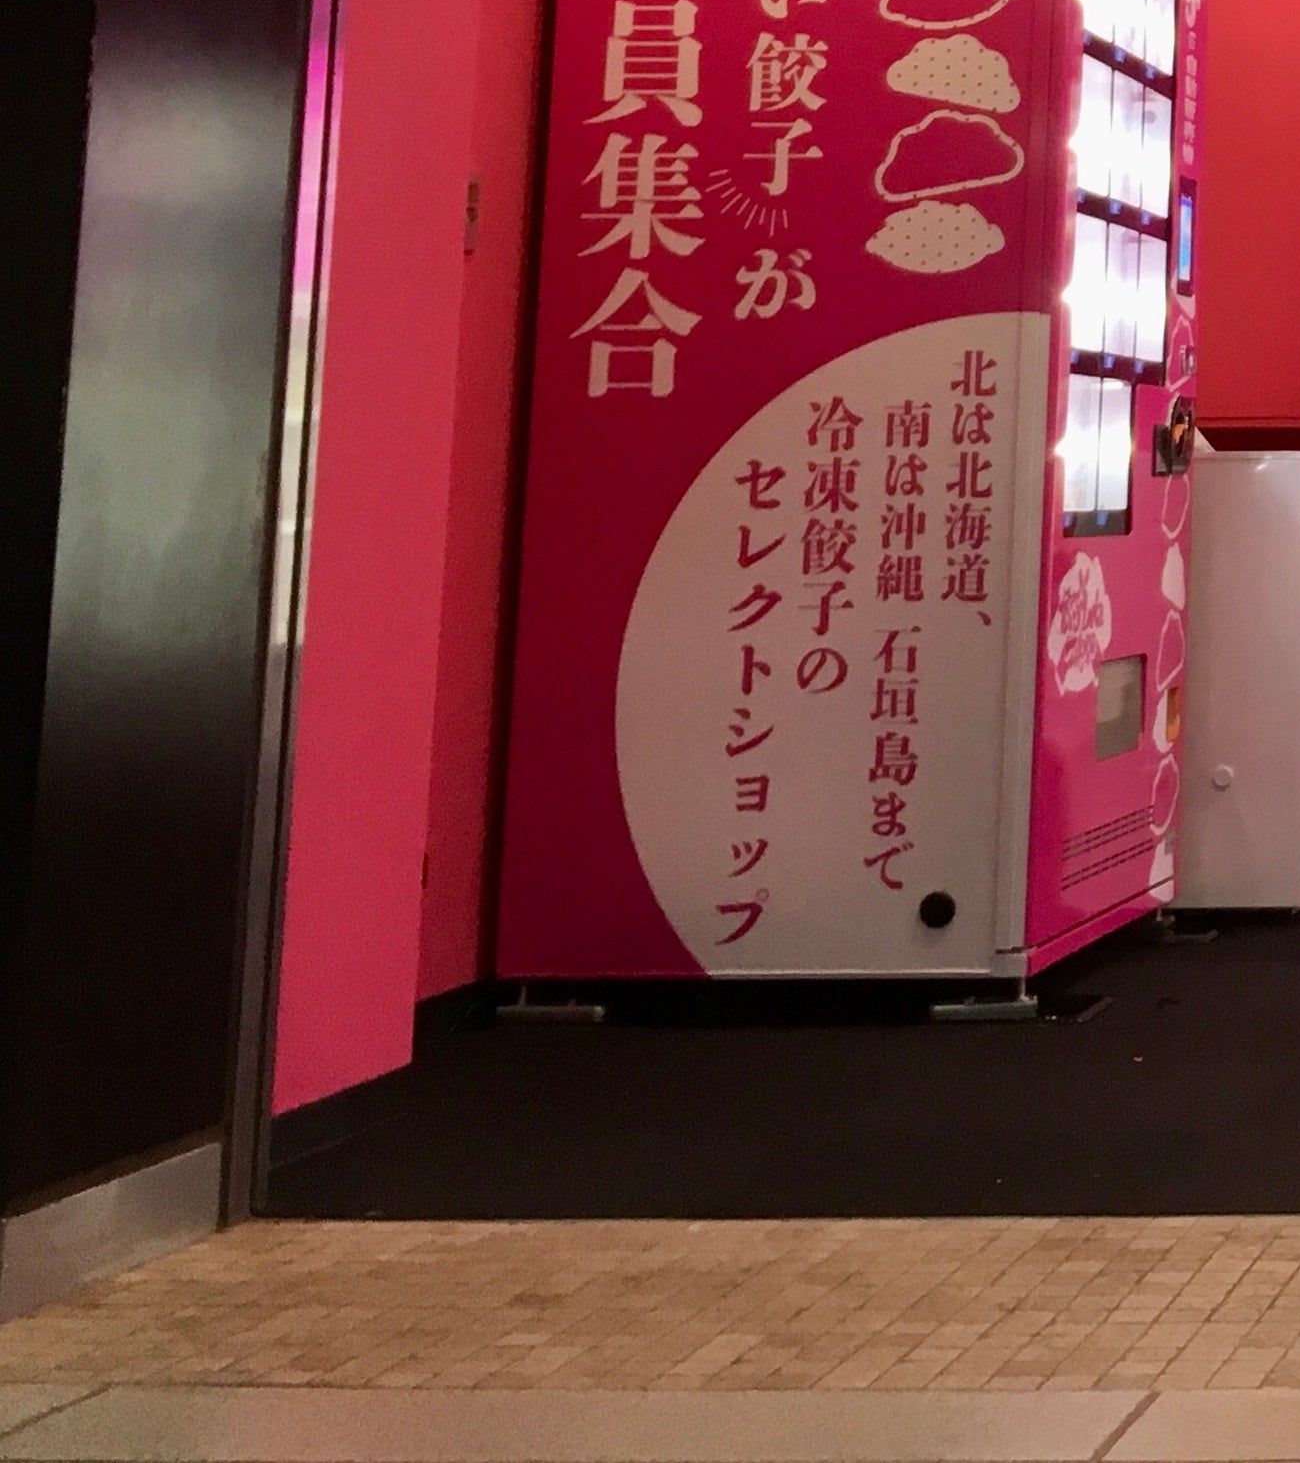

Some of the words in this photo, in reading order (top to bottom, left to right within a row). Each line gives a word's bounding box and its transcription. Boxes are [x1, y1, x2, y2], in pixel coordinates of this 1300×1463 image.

[796, 395, 864, 694] 冷凍餃子の
[715, 460, 786, 946] セレクトショップ
[863, 627, 919, 891] 石垣島まで
